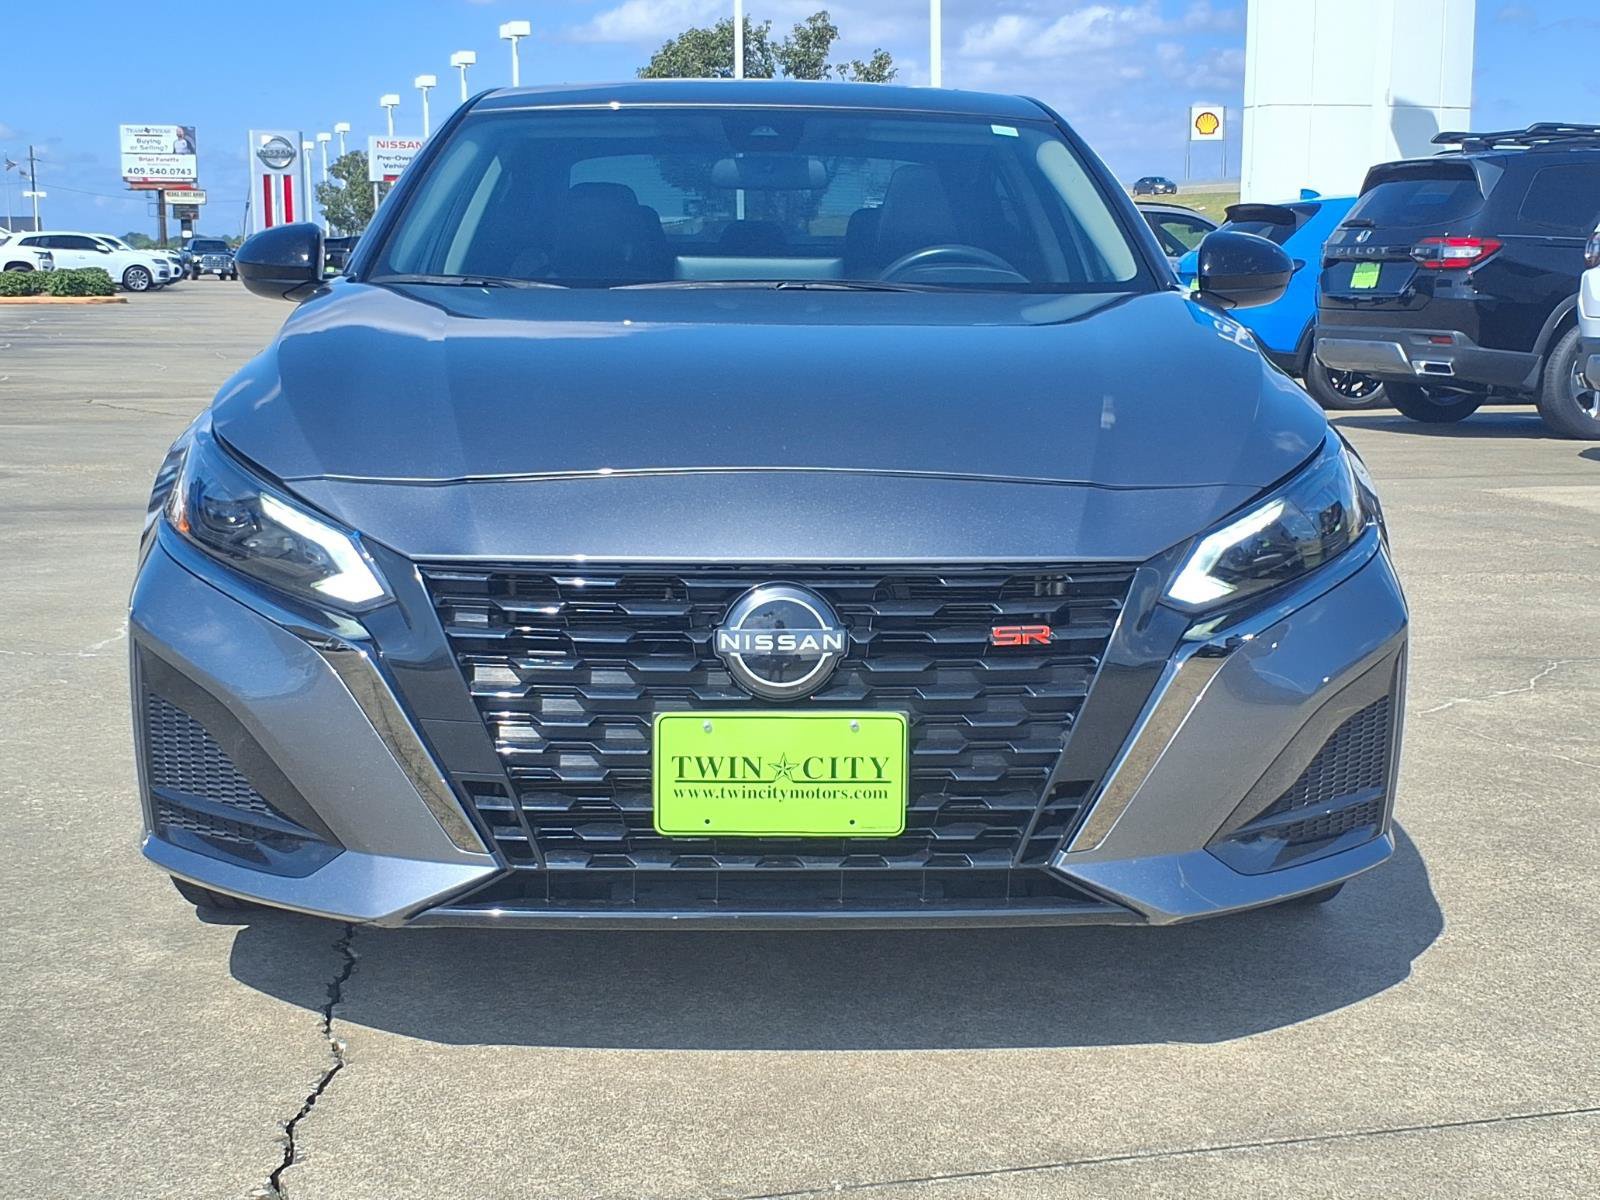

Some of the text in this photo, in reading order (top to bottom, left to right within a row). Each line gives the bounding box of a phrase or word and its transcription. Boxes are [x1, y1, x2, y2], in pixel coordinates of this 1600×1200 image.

[127, 167, 192, 175] 409.540.0743
[1336, 246, 1389, 256] PILOT
[721, 634, 842, 651] NISSAN
[992, 625, 1052, 646] SR
[671, 756, 890, 779] TWIN CITY
[673, 785, 888, 803] www.twincitymotors.com
